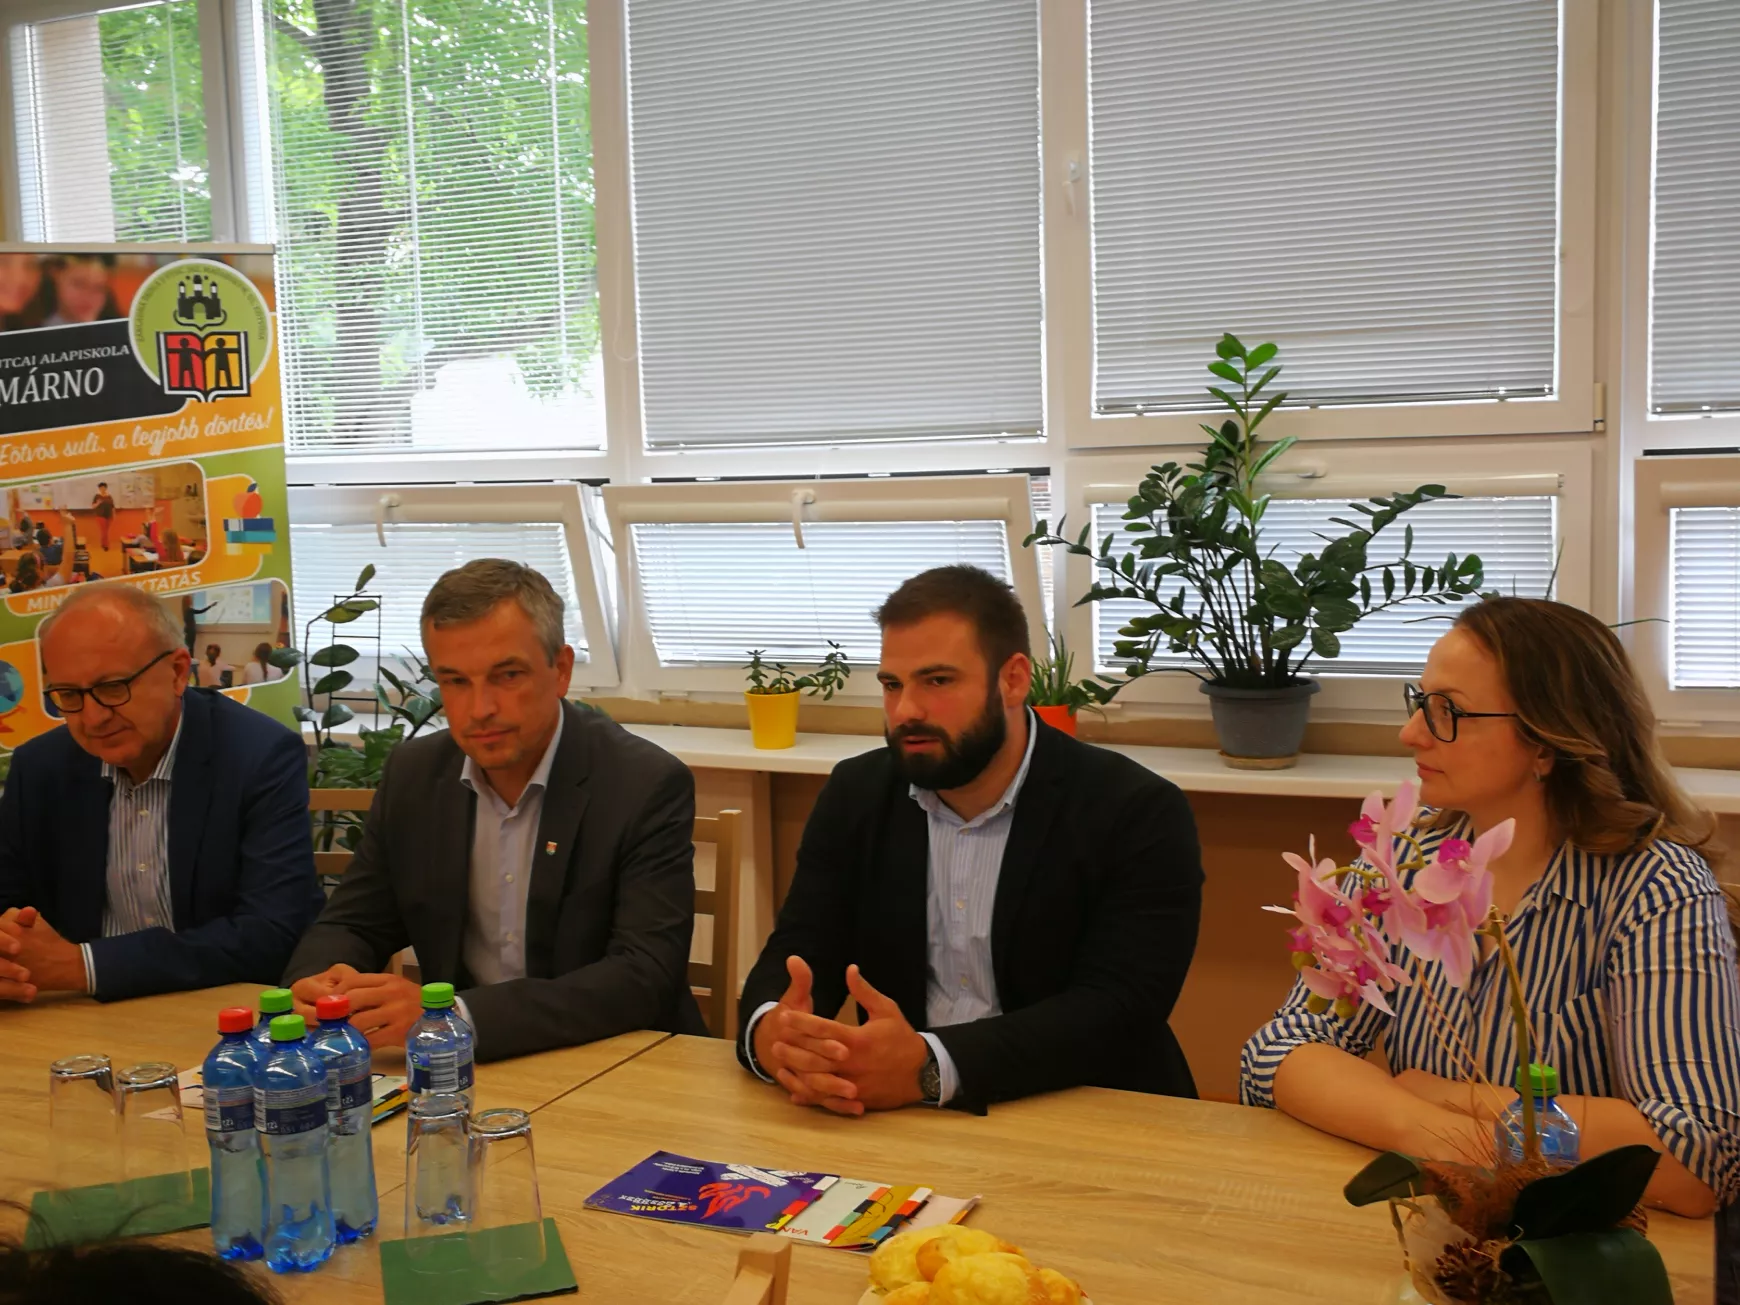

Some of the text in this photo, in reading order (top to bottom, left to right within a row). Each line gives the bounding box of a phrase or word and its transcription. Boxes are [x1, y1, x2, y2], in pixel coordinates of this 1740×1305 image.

[40, 344, 130, 365] ALAPISKOLA
[112, 433, 128, 450] a
[132, 415, 200, 456] legjobb
[204, 406, 275, 437] döntés!
